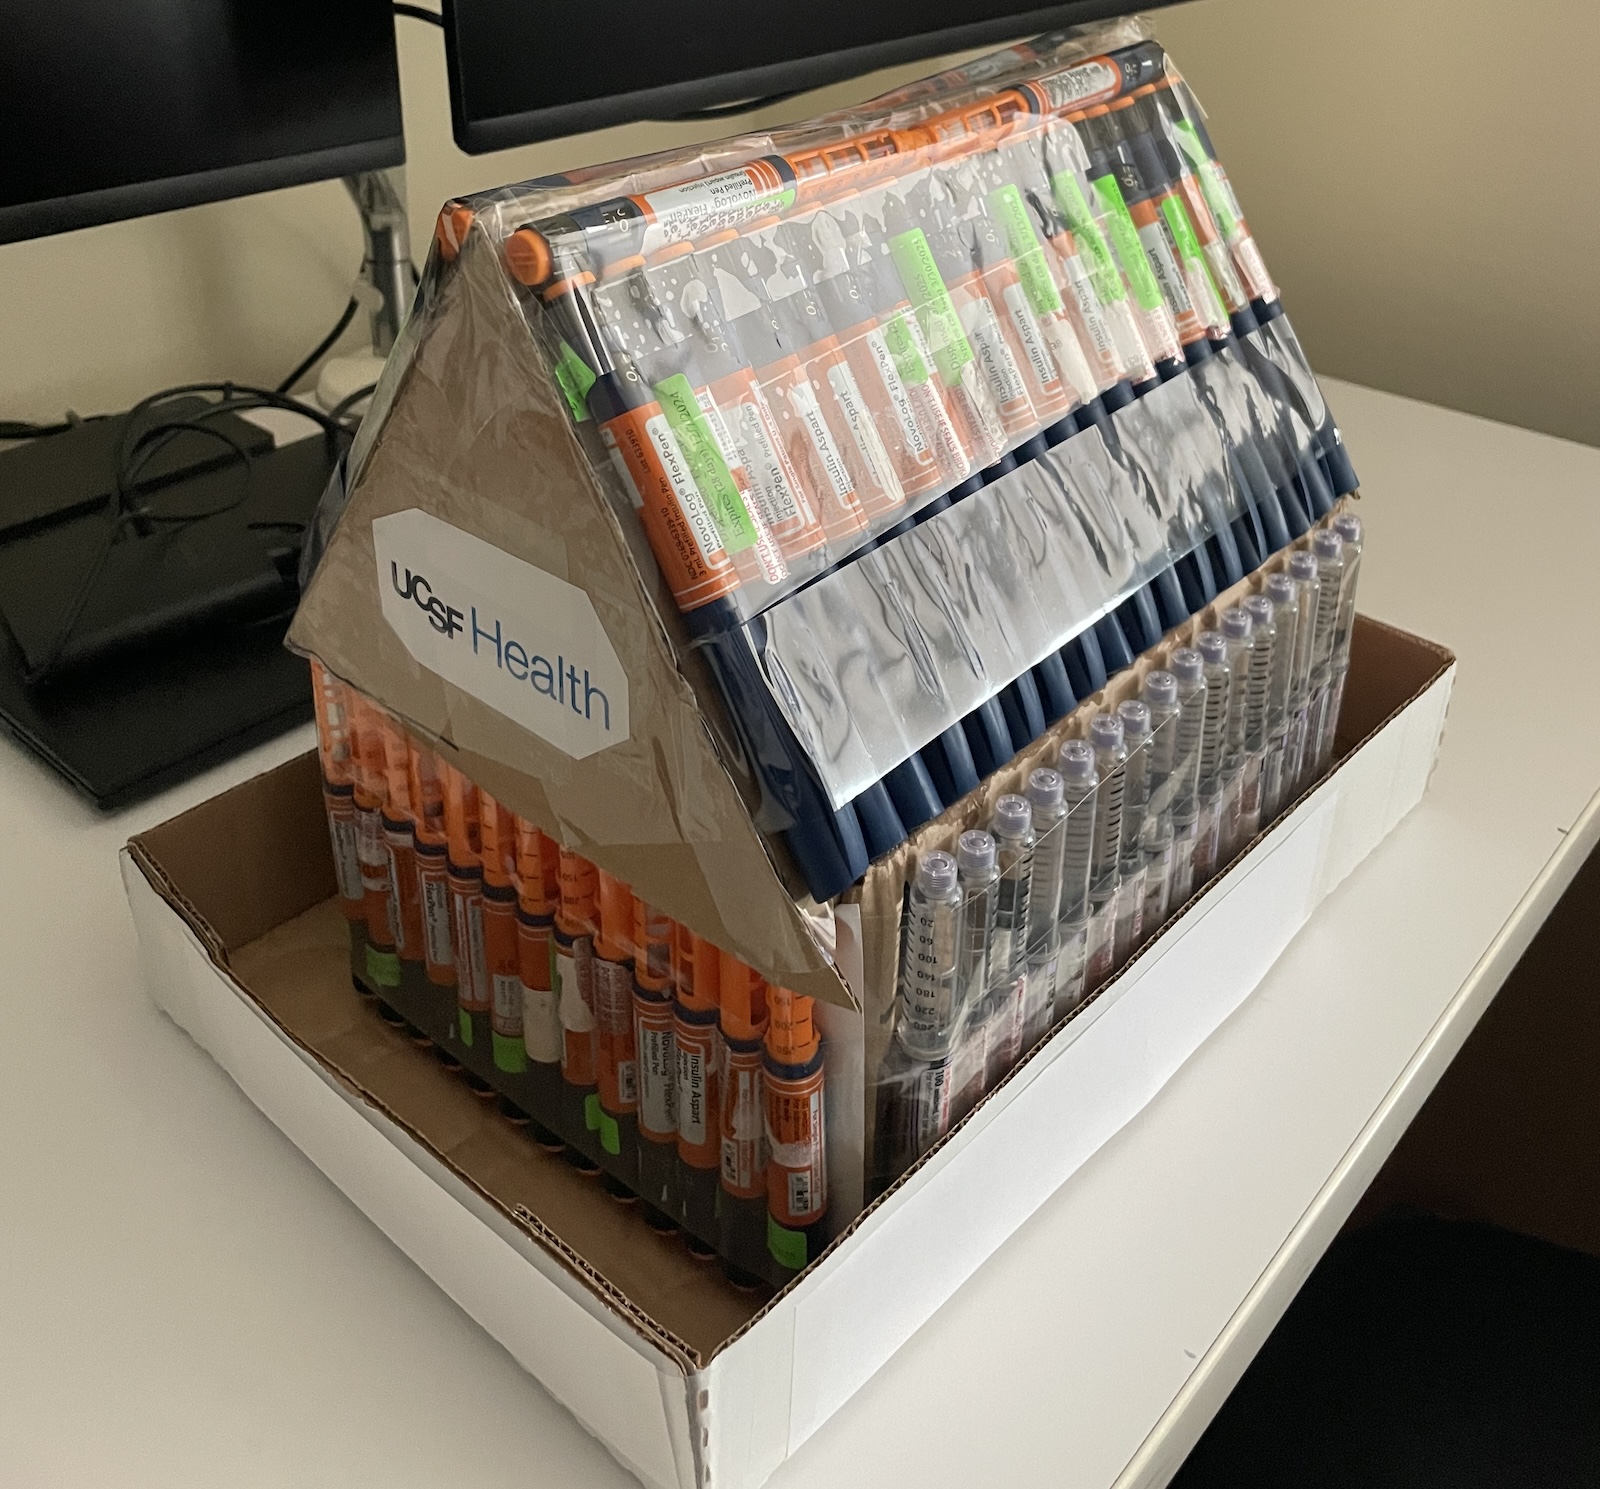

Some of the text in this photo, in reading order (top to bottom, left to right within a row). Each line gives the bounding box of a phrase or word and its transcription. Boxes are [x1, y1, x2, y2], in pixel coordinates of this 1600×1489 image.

[709, 177, 752, 195] Prefilled Pen
[1146, 247, 1168, 281] Aspart
[1071, 279, 1094, 315] Aspart
[1010, 307, 1037, 346] Aspart
[1085, 315, 1107, 351] Insulin
[971, 329, 995, 364] Aspar
[1026, 346, 1051, 384] Insulin
[984, 364, 1010, 404] Insulin
[743, 404, 757, 422] Pen
[929, 403, 942, 420] USE
[937, 418, 946, 427] IF
[803, 409, 831, 453] Aspart
[940, 427, 957, 452] SEAL'S
[696, 447, 718, 476] days)
[822, 453, 849, 496] Insulin
[657, 476, 670, 493] Pen
[709, 474, 725, 493] (28
[664, 492, 682, 521] Insulin
[717, 492, 747, 537] Expires
[676, 520, 698, 555] Prefilled
[391, 560, 609, 730] UCSF Health
[920, 916, 932, 927] 20
[919, 935, 932, 945] 60
[918, 952, 937, 964] 100
[916, 969, 935, 981] 140
[915, 987, 935, 998] 180
[914, 1004, 934, 1015] 220
[649, 1031, 659, 1060] Prefilled
[688, 1054, 703, 1124] Insulin Aspart
[934, 1069, 944, 1086] 100
